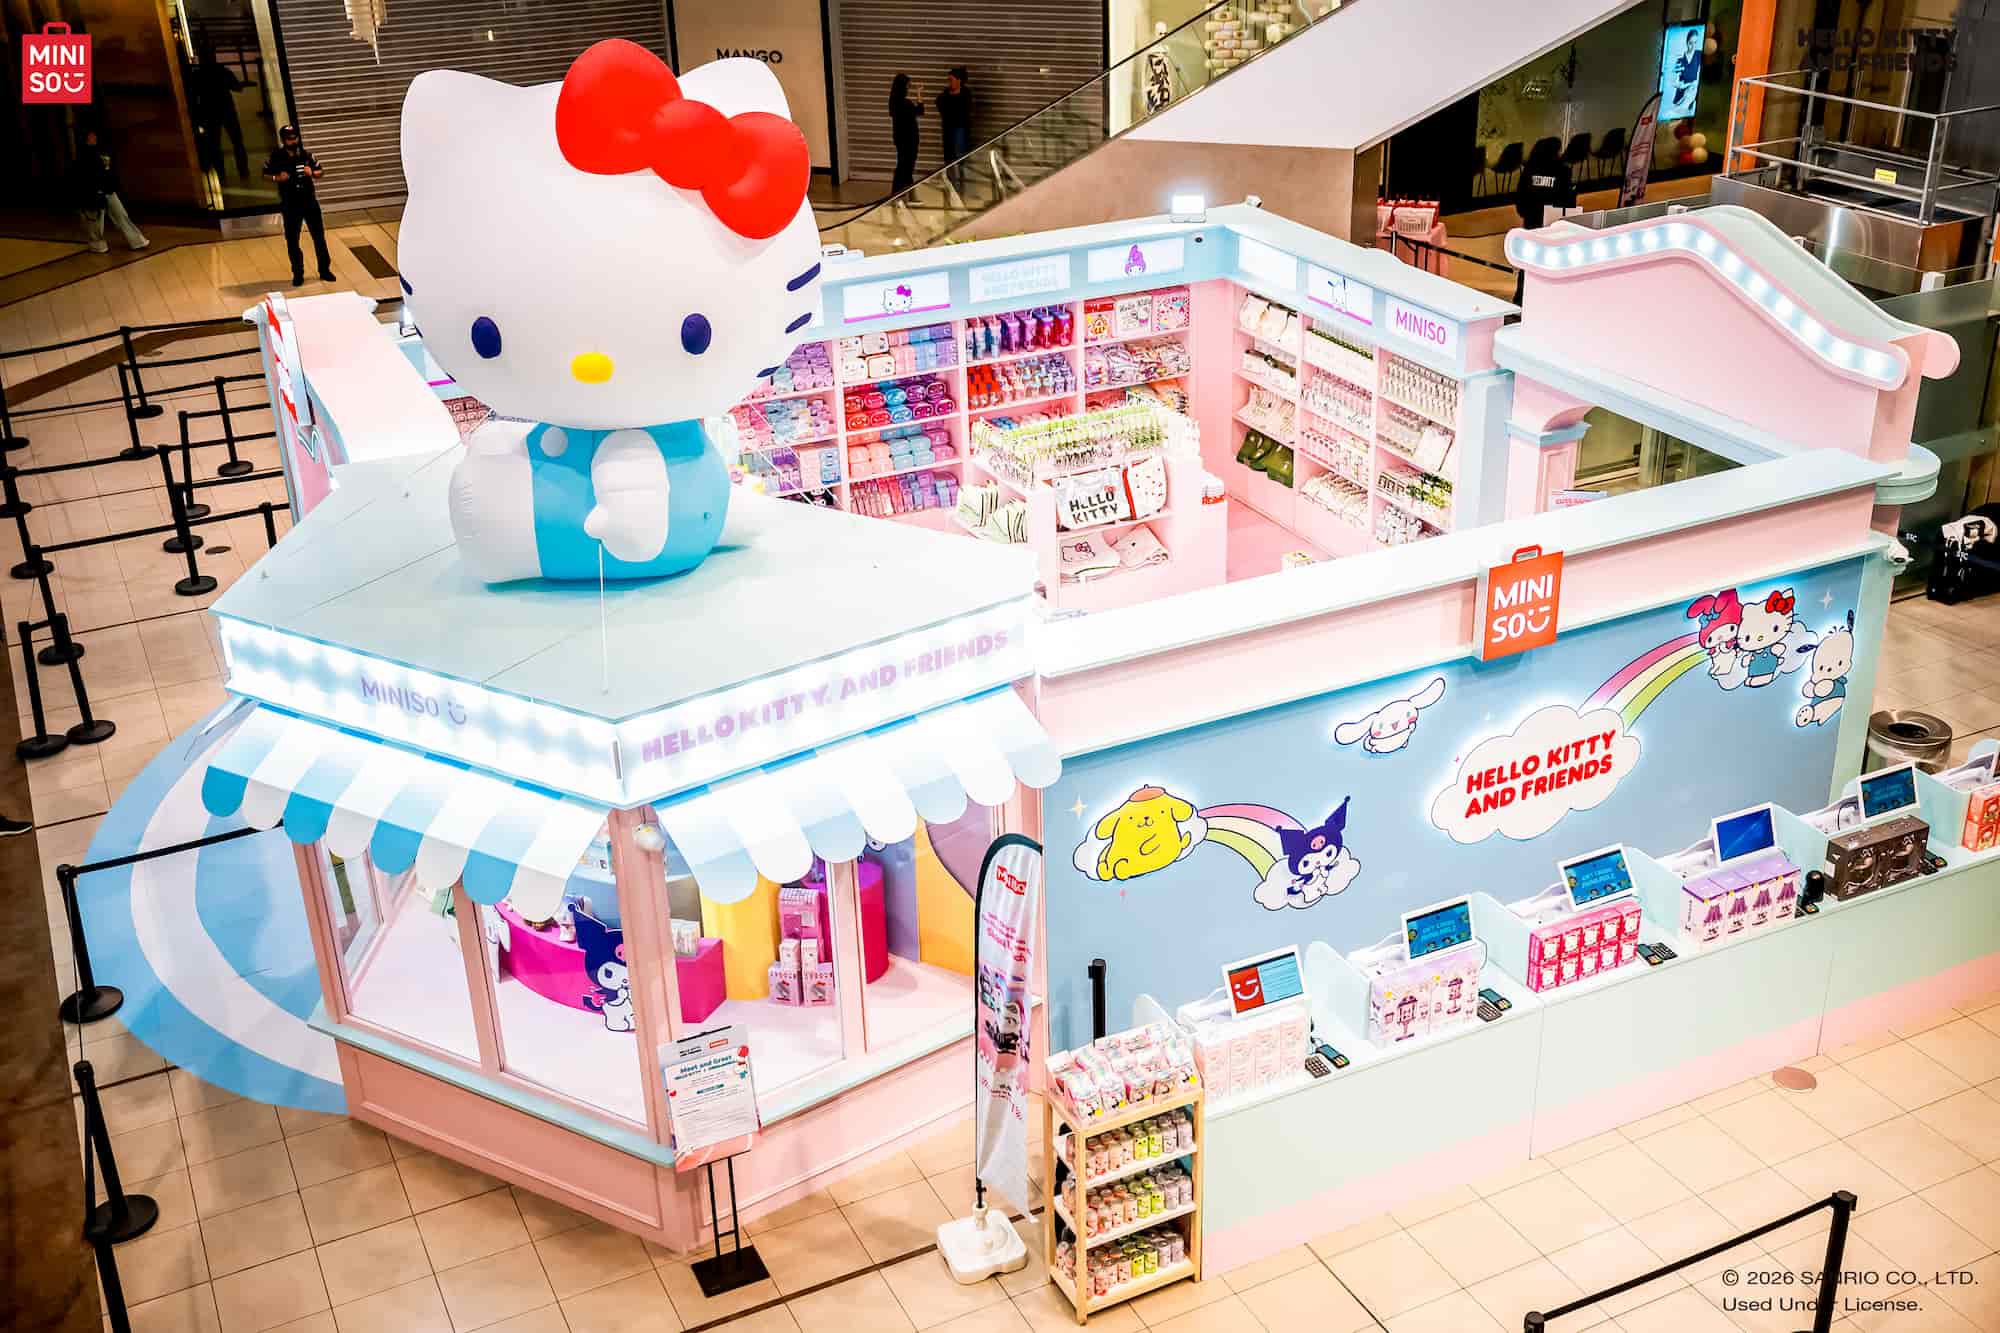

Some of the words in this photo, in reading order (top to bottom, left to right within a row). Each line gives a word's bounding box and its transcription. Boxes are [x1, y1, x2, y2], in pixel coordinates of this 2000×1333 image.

[716, 48, 783, 64] MANGO
[1395, 307, 1447, 345] MINISO
[1072, 503, 1119, 525] KITTY
[1493, 574, 1554, 611] MINI
[360, 677, 440, 717] MINISO
[641, 714, 736, 763] HELLO
[739, 682, 830, 732] KITTY
[839, 664, 898, 701] AND
[904, 630, 1009, 678] FRIENDS
[1466, 754, 1541, 795] HELLO
[1547, 728, 1617, 769] KITTY
[1464, 786, 1517, 819] AND
[1521, 753, 1613, 801] FRIENDS
